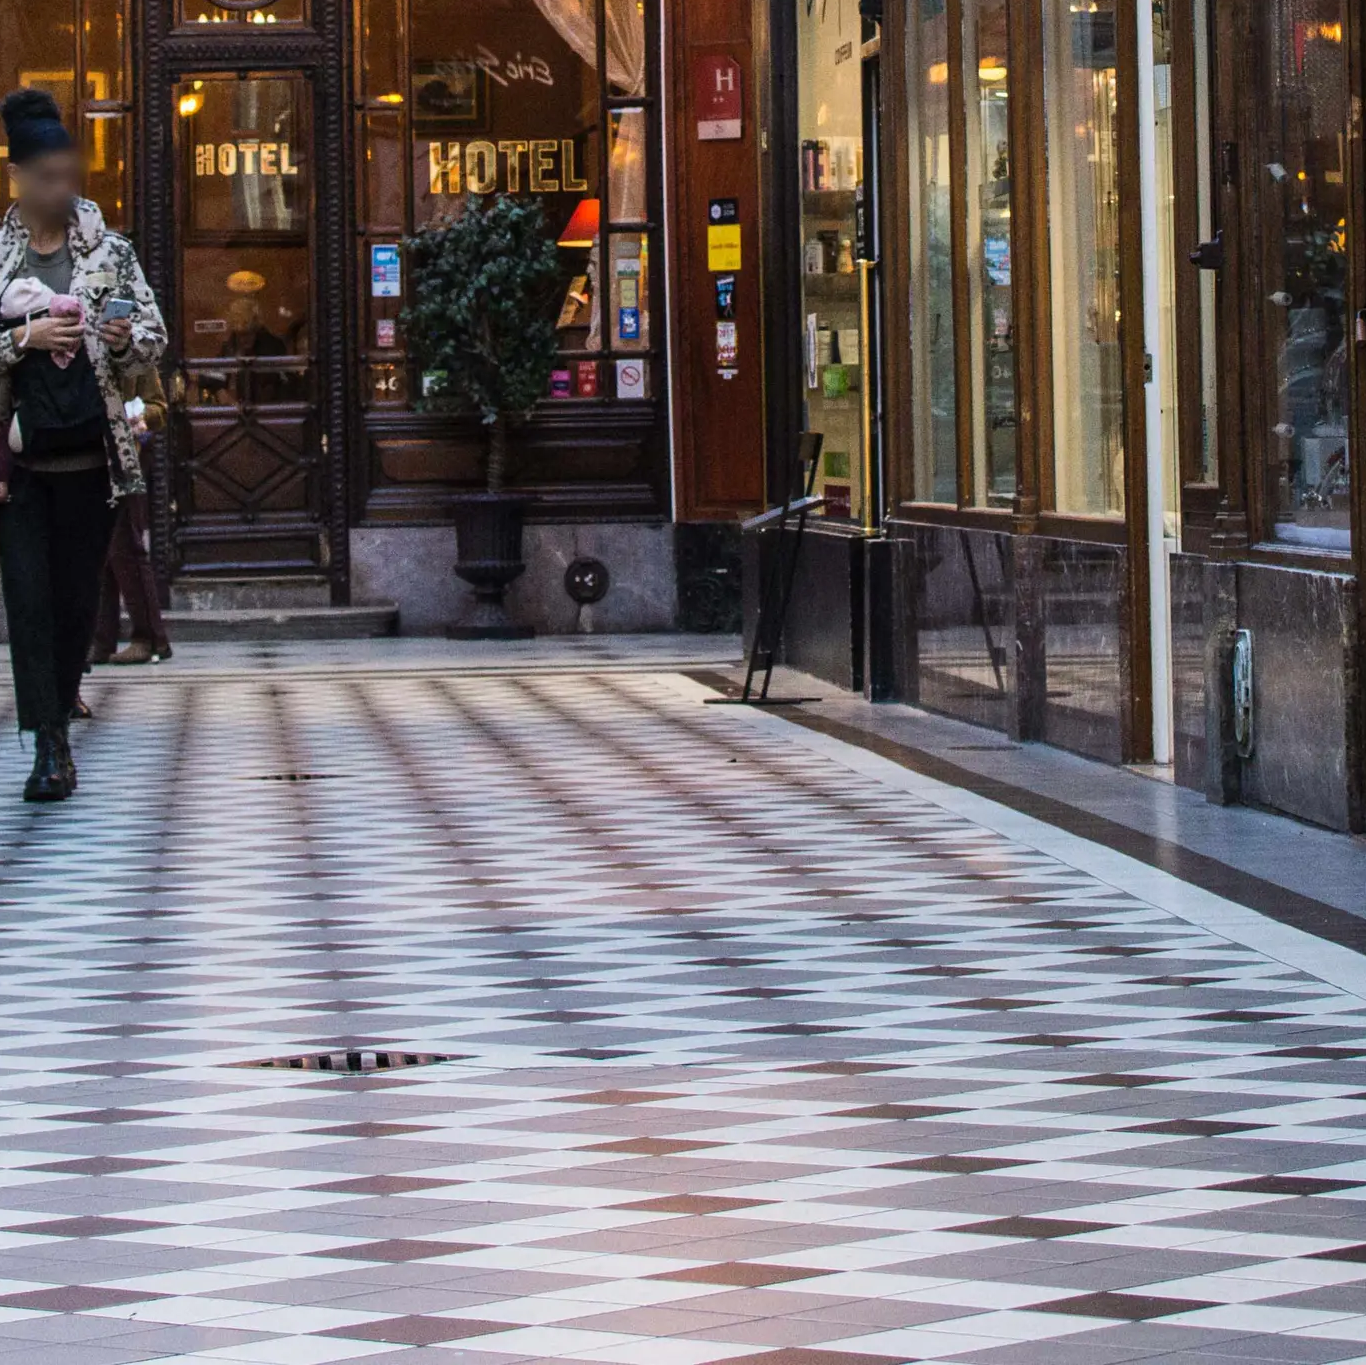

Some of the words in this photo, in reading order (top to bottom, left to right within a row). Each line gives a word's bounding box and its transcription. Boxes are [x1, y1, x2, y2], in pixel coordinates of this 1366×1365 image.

[715, 68, 734, 91] H
[195, 142, 298, 176] HOTEL
[428, 138, 589, 195] HOTEL
